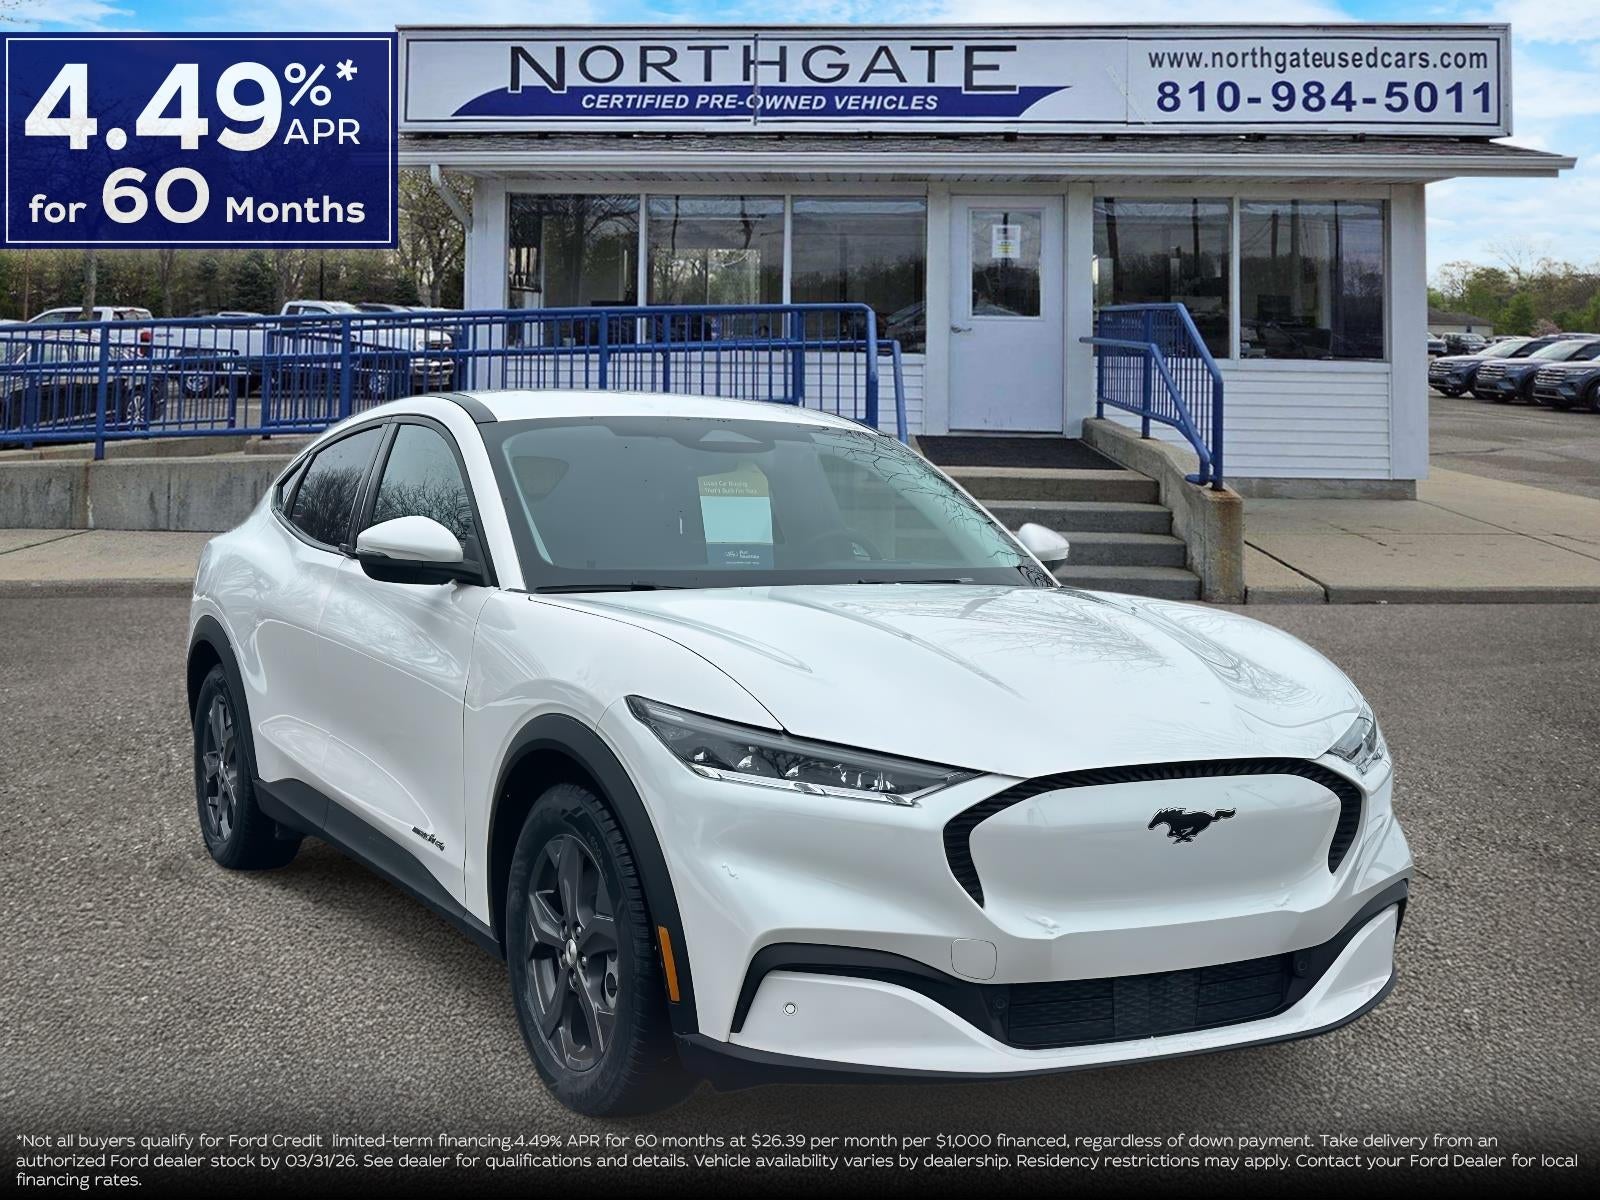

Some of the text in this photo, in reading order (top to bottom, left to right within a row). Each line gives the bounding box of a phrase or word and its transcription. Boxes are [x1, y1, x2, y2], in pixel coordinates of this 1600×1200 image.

[509, 43, 1018, 93] NORTHGATE
[1148, 46, 1489, 74] www.northgateusedcars.com
[581, 94, 939, 112] CERTIFIED PRE-OWNED VEHICLES
[1156, 80, 1492, 114] 810-984-5011
